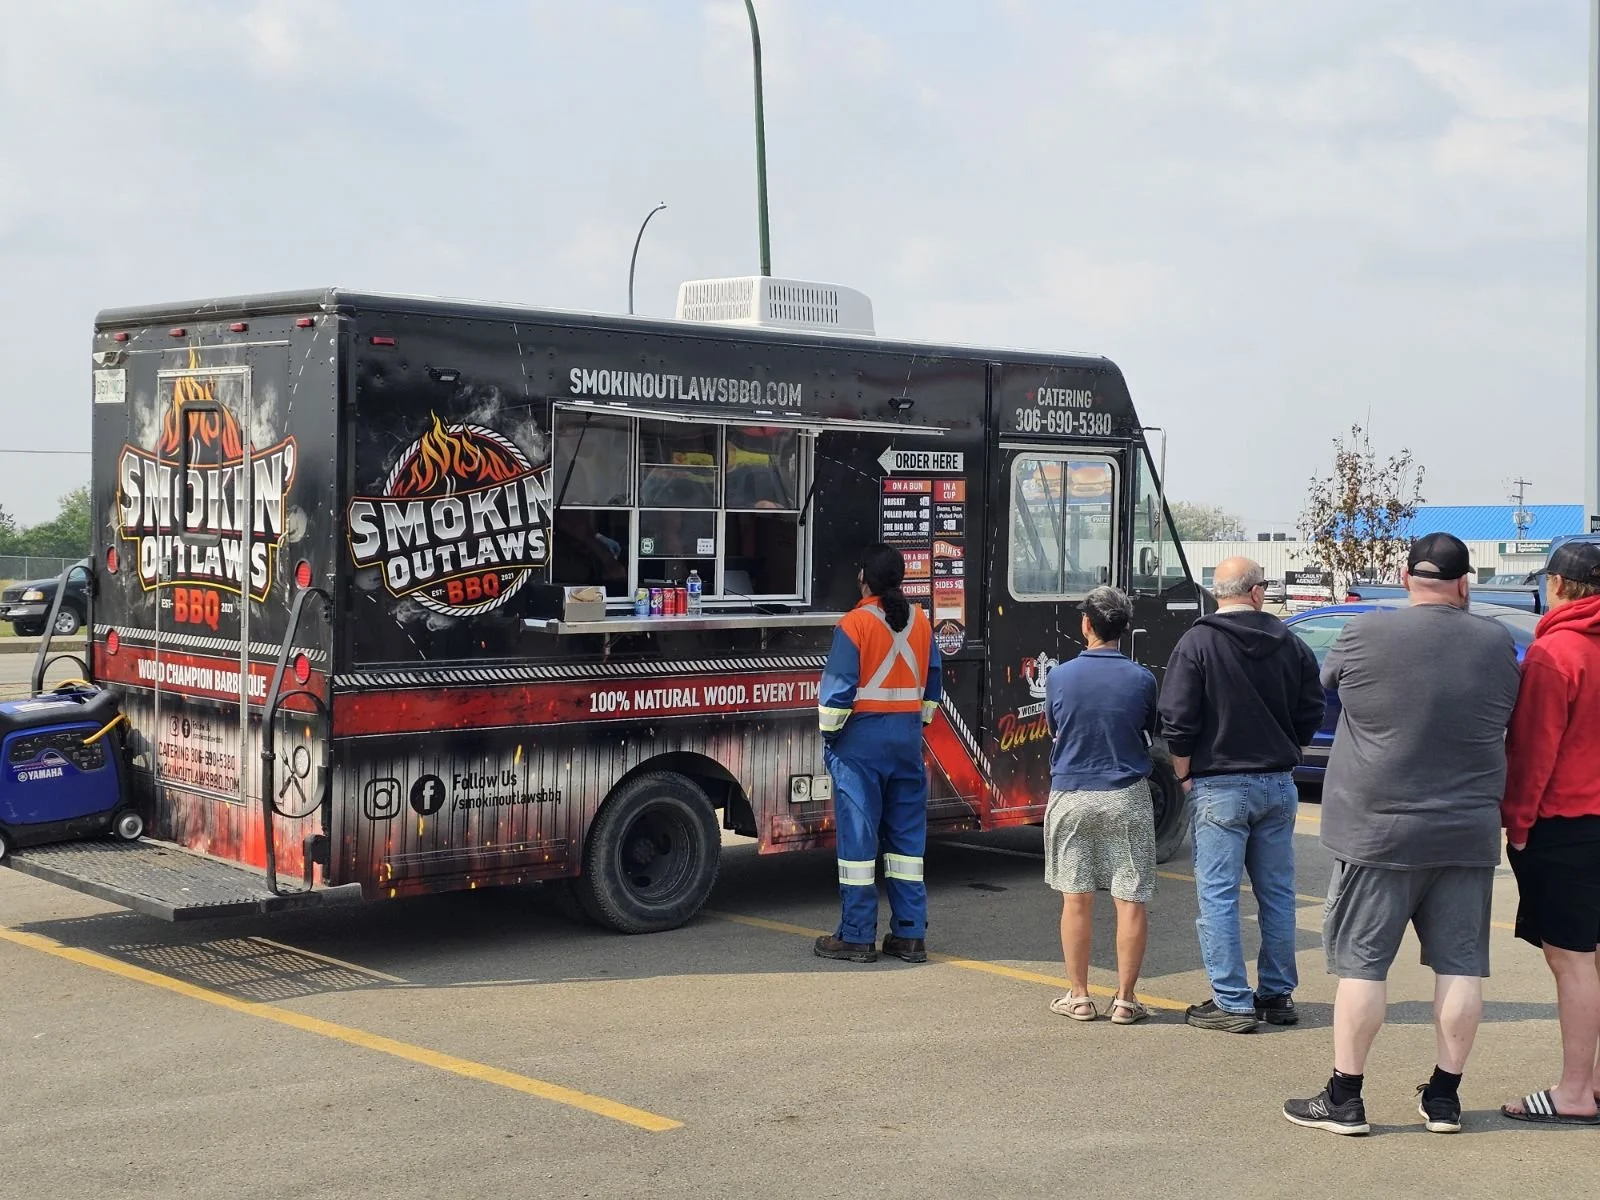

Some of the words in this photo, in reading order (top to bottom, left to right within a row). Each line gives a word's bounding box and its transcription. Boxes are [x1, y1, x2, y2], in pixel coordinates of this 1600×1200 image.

[569, 367, 802, 406] SMOKINOUTLAWSBBQ.COM
[1037, 387, 1092, 408] CATERING
[1015, 407, 1112, 435] 306-690-5380
[895, 452, 930, 469] ORDER
[932, 453, 958, 470] HERE
[892, 482, 902, 490] ON
[909, 482, 924, 490] BUN
[943, 482, 950, 490] IN
[951, 482, 956, 490] A
[943, 491, 956, 499] CUP
[386, 527, 546, 590] OUTLAWS
[935, 543, 961, 557] DRINKS
[141, 535, 268, 590] OUTLAWS
[501, 572, 515, 581] 2021
[935, 580, 954, 589] SIDES
[446, 572, 500, 605] BBQ
[903, 585, 930, 593] COMBOS
[174, 587, 219, 631] BBQ
[138, 658, 165, 682] WORD
[166, 662, 213, 689] CHAMPION
[214, 669, 267, 697] BARBQUE
[589, 690, 630, 713] 100%
[634, 686, 700, 710] NATURAL
[703, 684, 749, 706] WOOD.
[752, 681, 795, 704] EVERY
[797, 680, 821, 700] TIM
[159, 742, 190, 762] CATERING
[28, 767, 63, 780] YAMAHA
[452, 773, 498, 791] Follow
[501, 770, 517, 786] Us
[452, 788, 562, 813] /smokinoutlawsbbq
